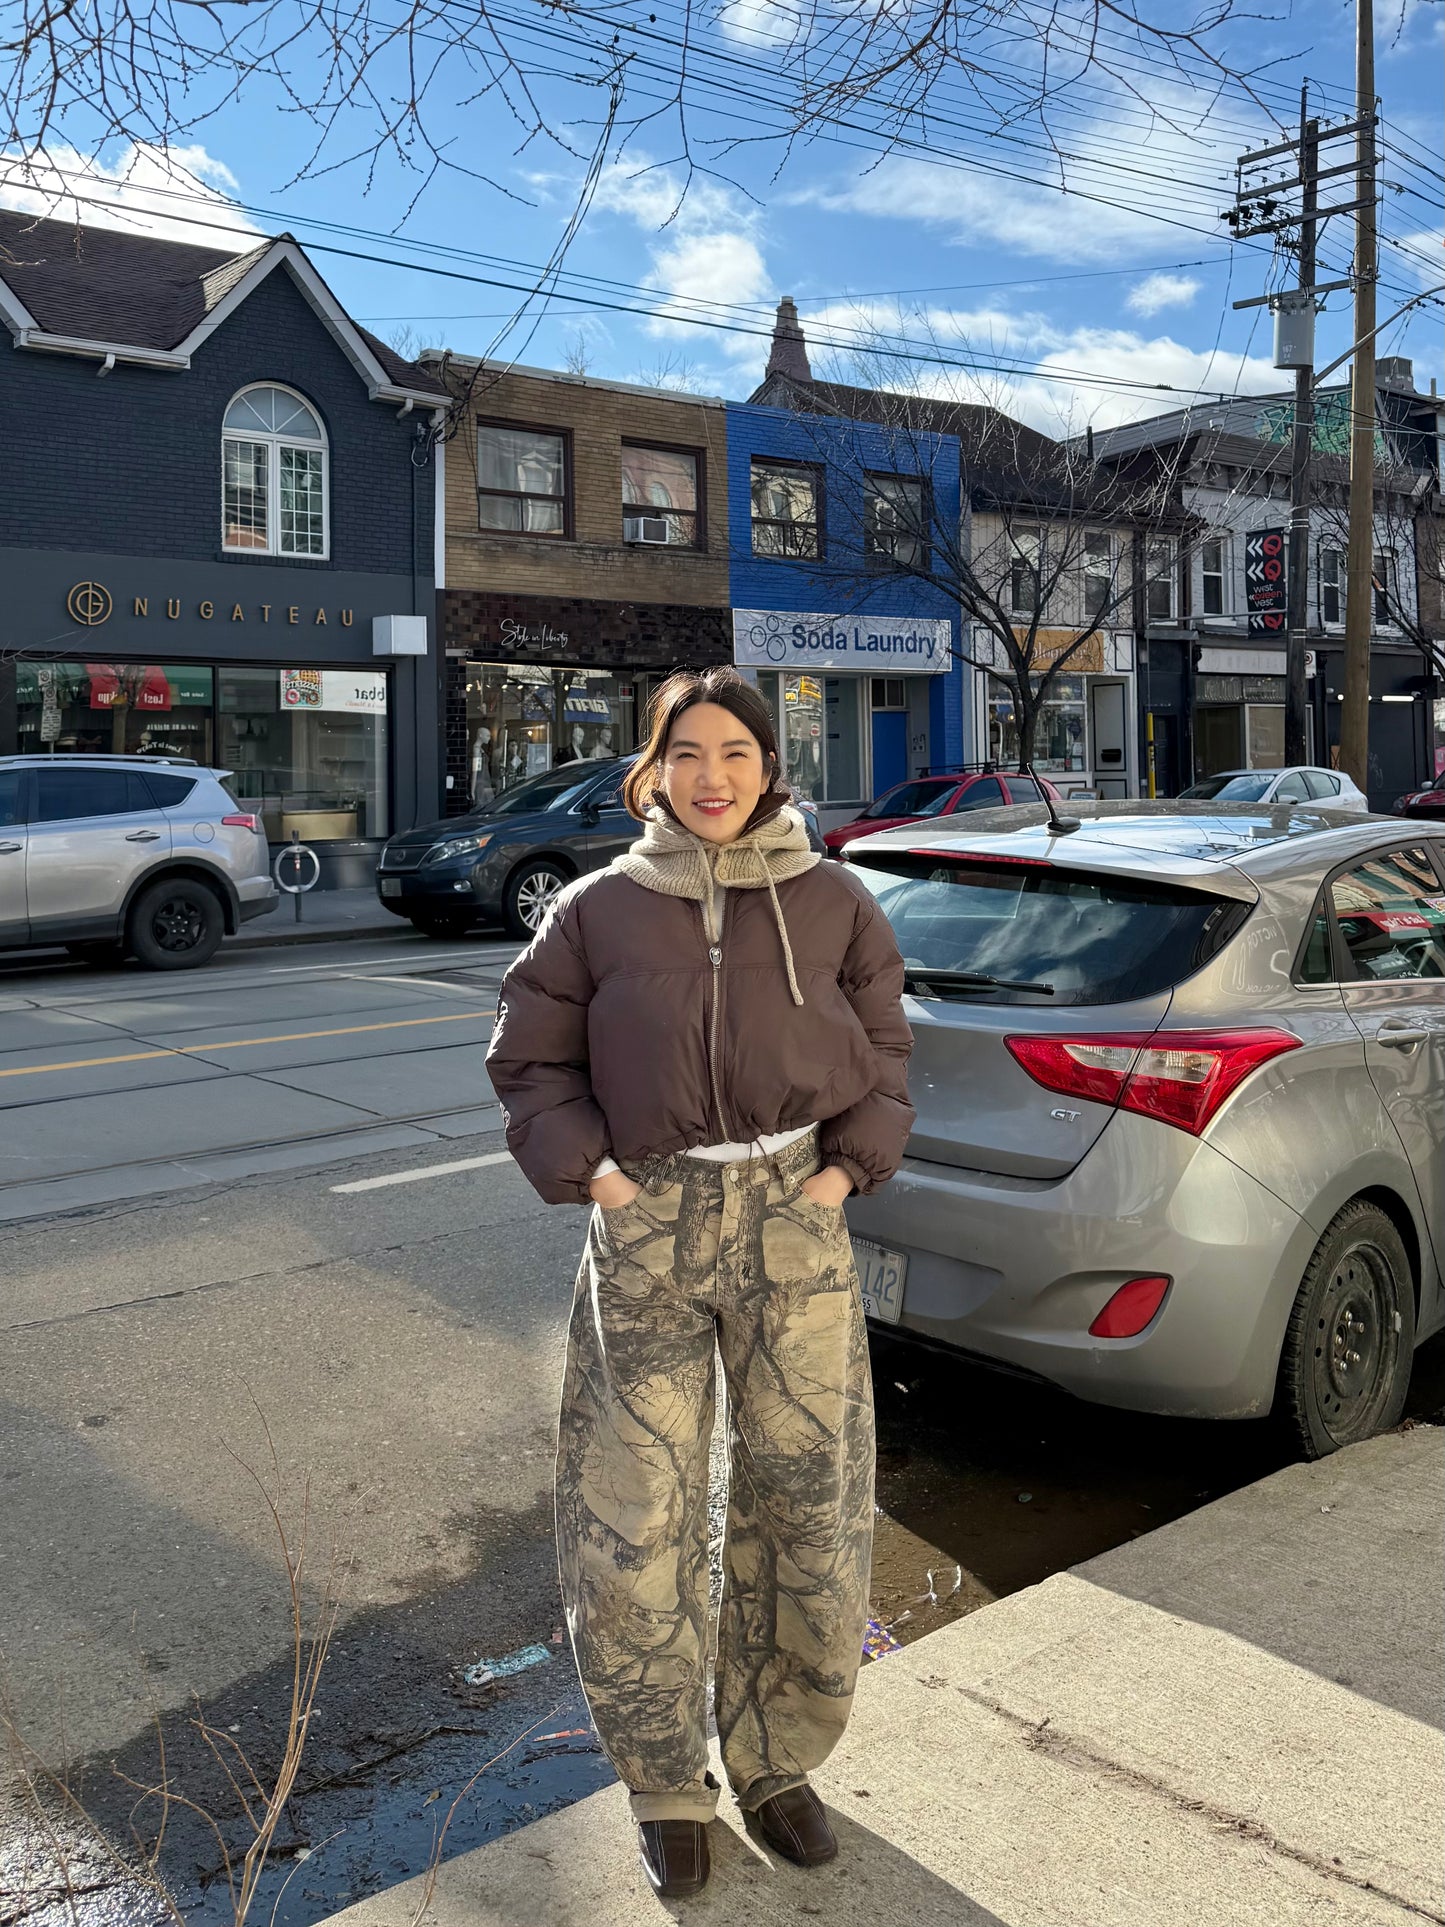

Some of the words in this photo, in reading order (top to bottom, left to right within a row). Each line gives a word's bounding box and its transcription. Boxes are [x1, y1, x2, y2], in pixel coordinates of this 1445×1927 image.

[133, 596, 354, 627] NUGATEAU
[500, 618, 530, 648] Style
[791, 623, 848, 651] Soda
[854, 627, 937, 659] Laundry
[1050, 1108, 1082, 1123] GT
